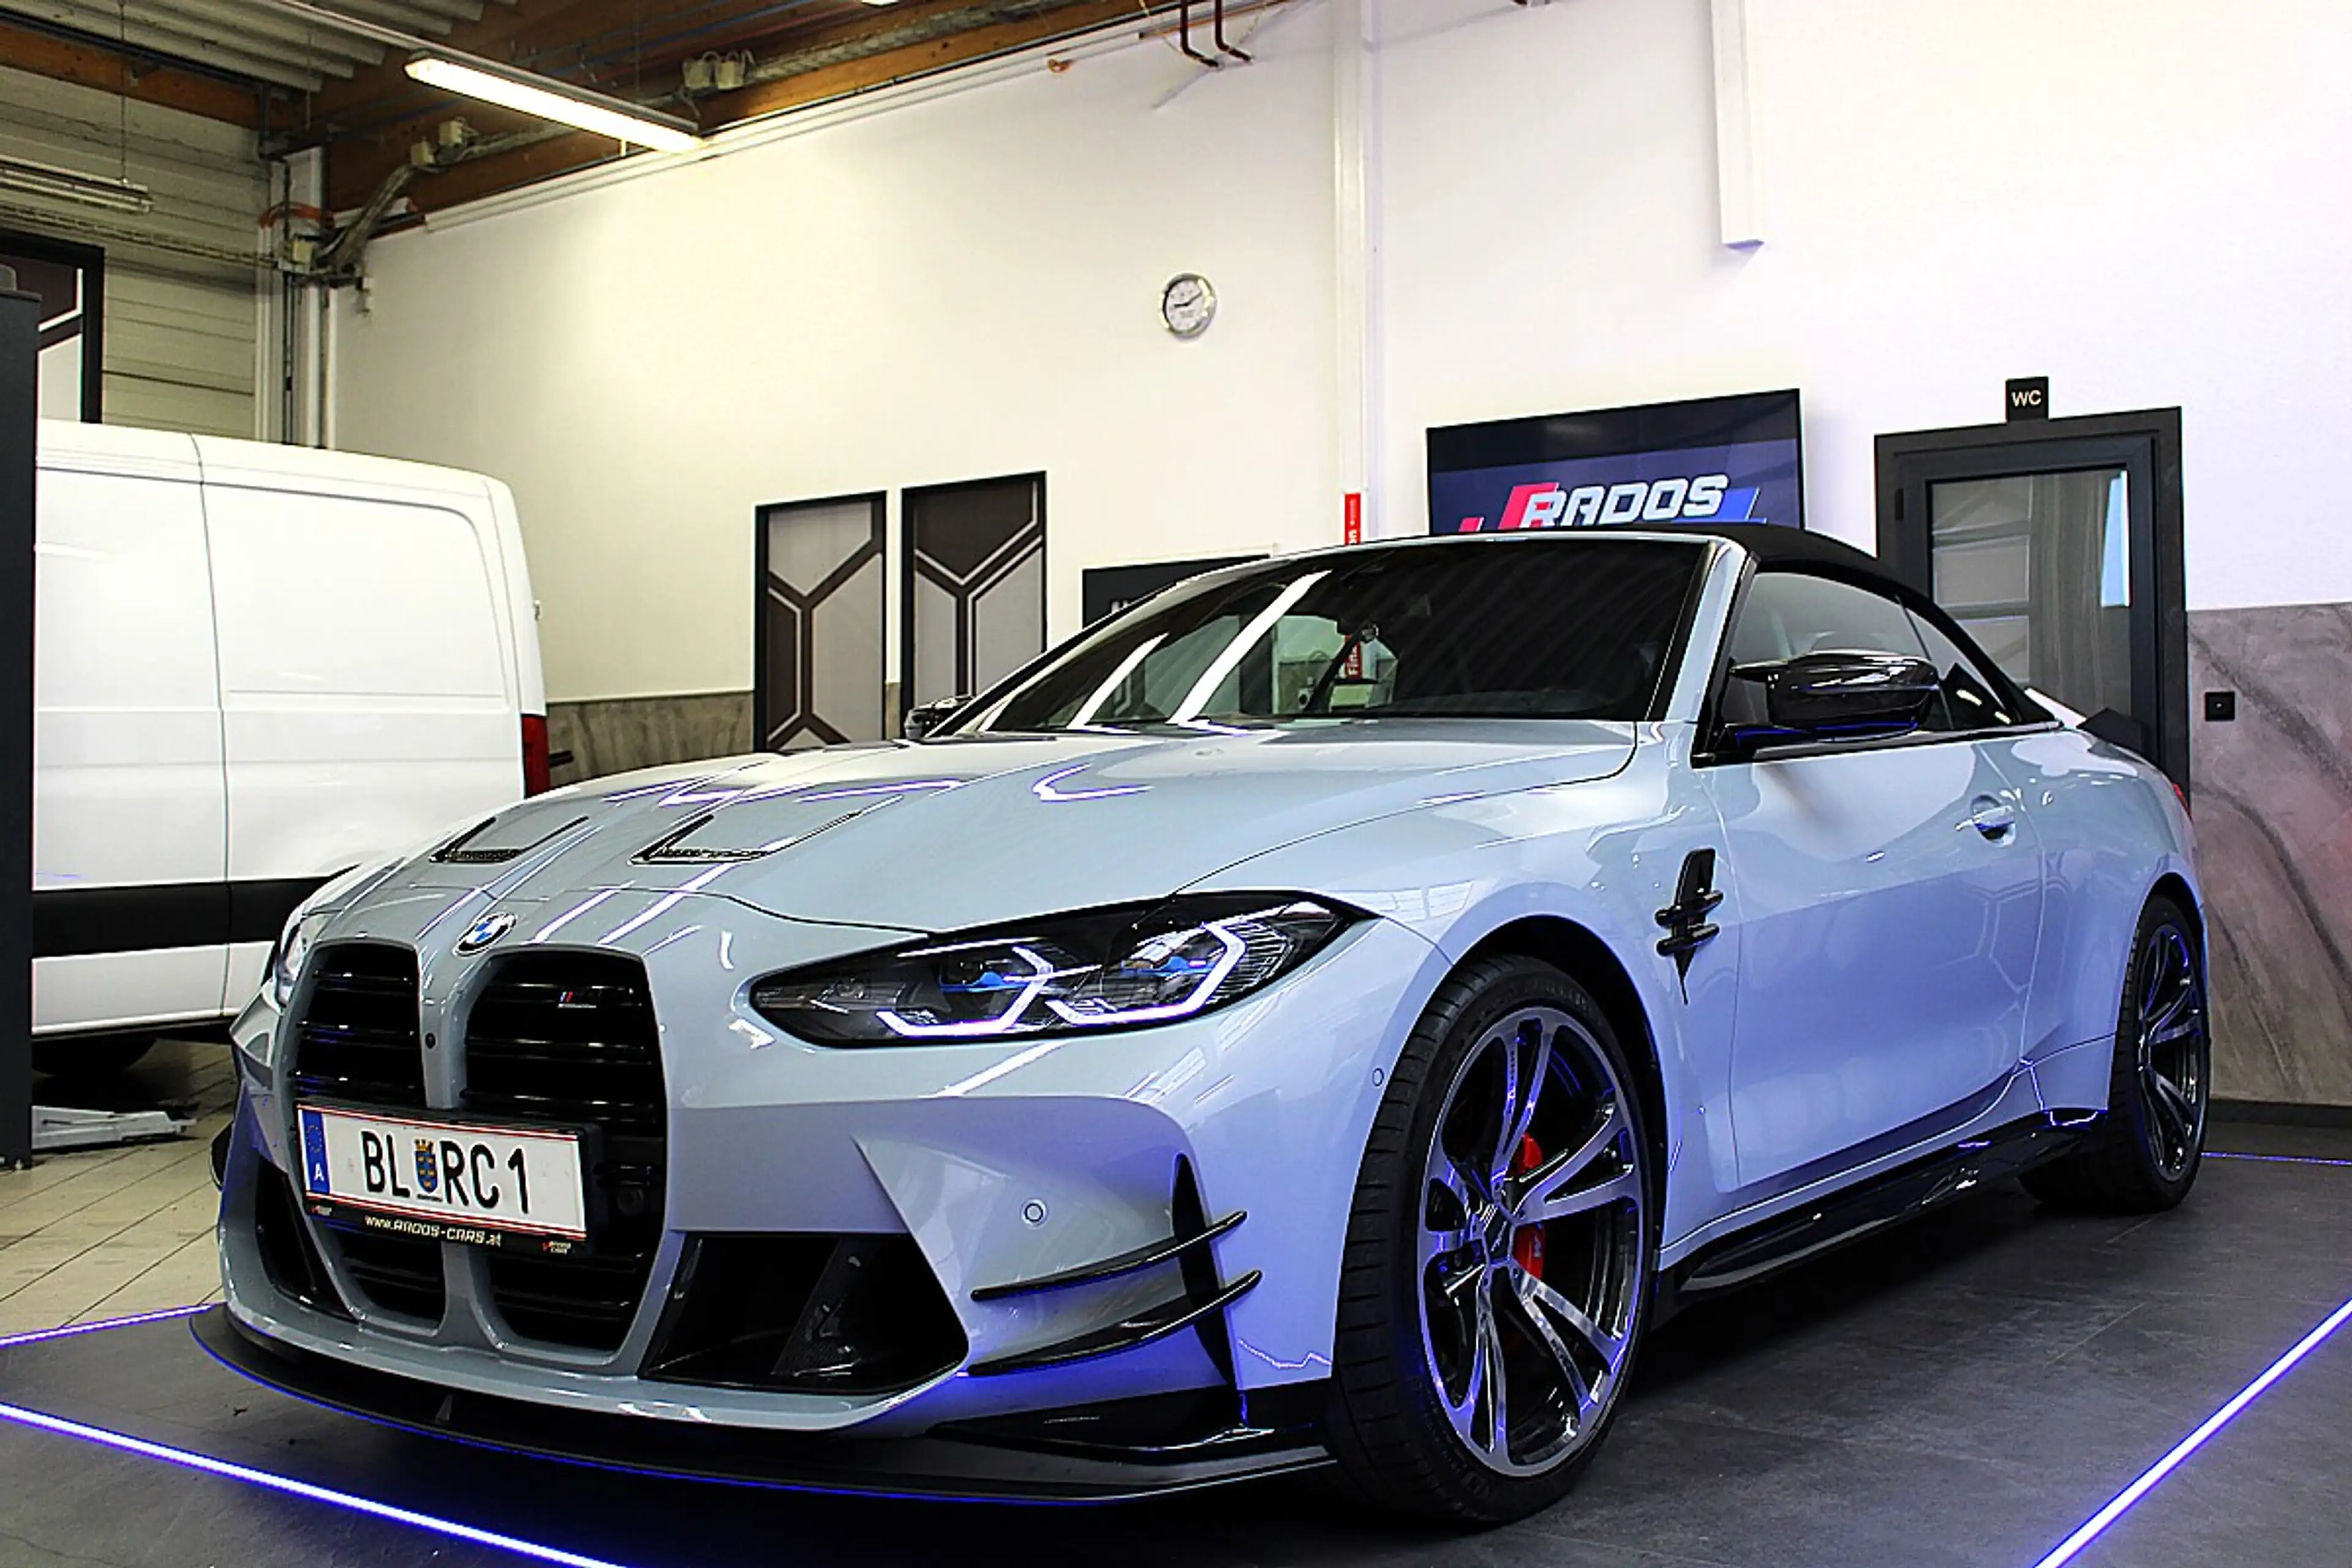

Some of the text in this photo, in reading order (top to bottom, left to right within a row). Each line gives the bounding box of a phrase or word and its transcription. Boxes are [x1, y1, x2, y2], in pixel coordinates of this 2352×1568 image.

[2011, 390, 2041, 407] WC
[1520, 474, 1730, 528] RADOS
[313, 1163, 325, 1182] A
[361, 1131, 529, 1214] BL RC 1
